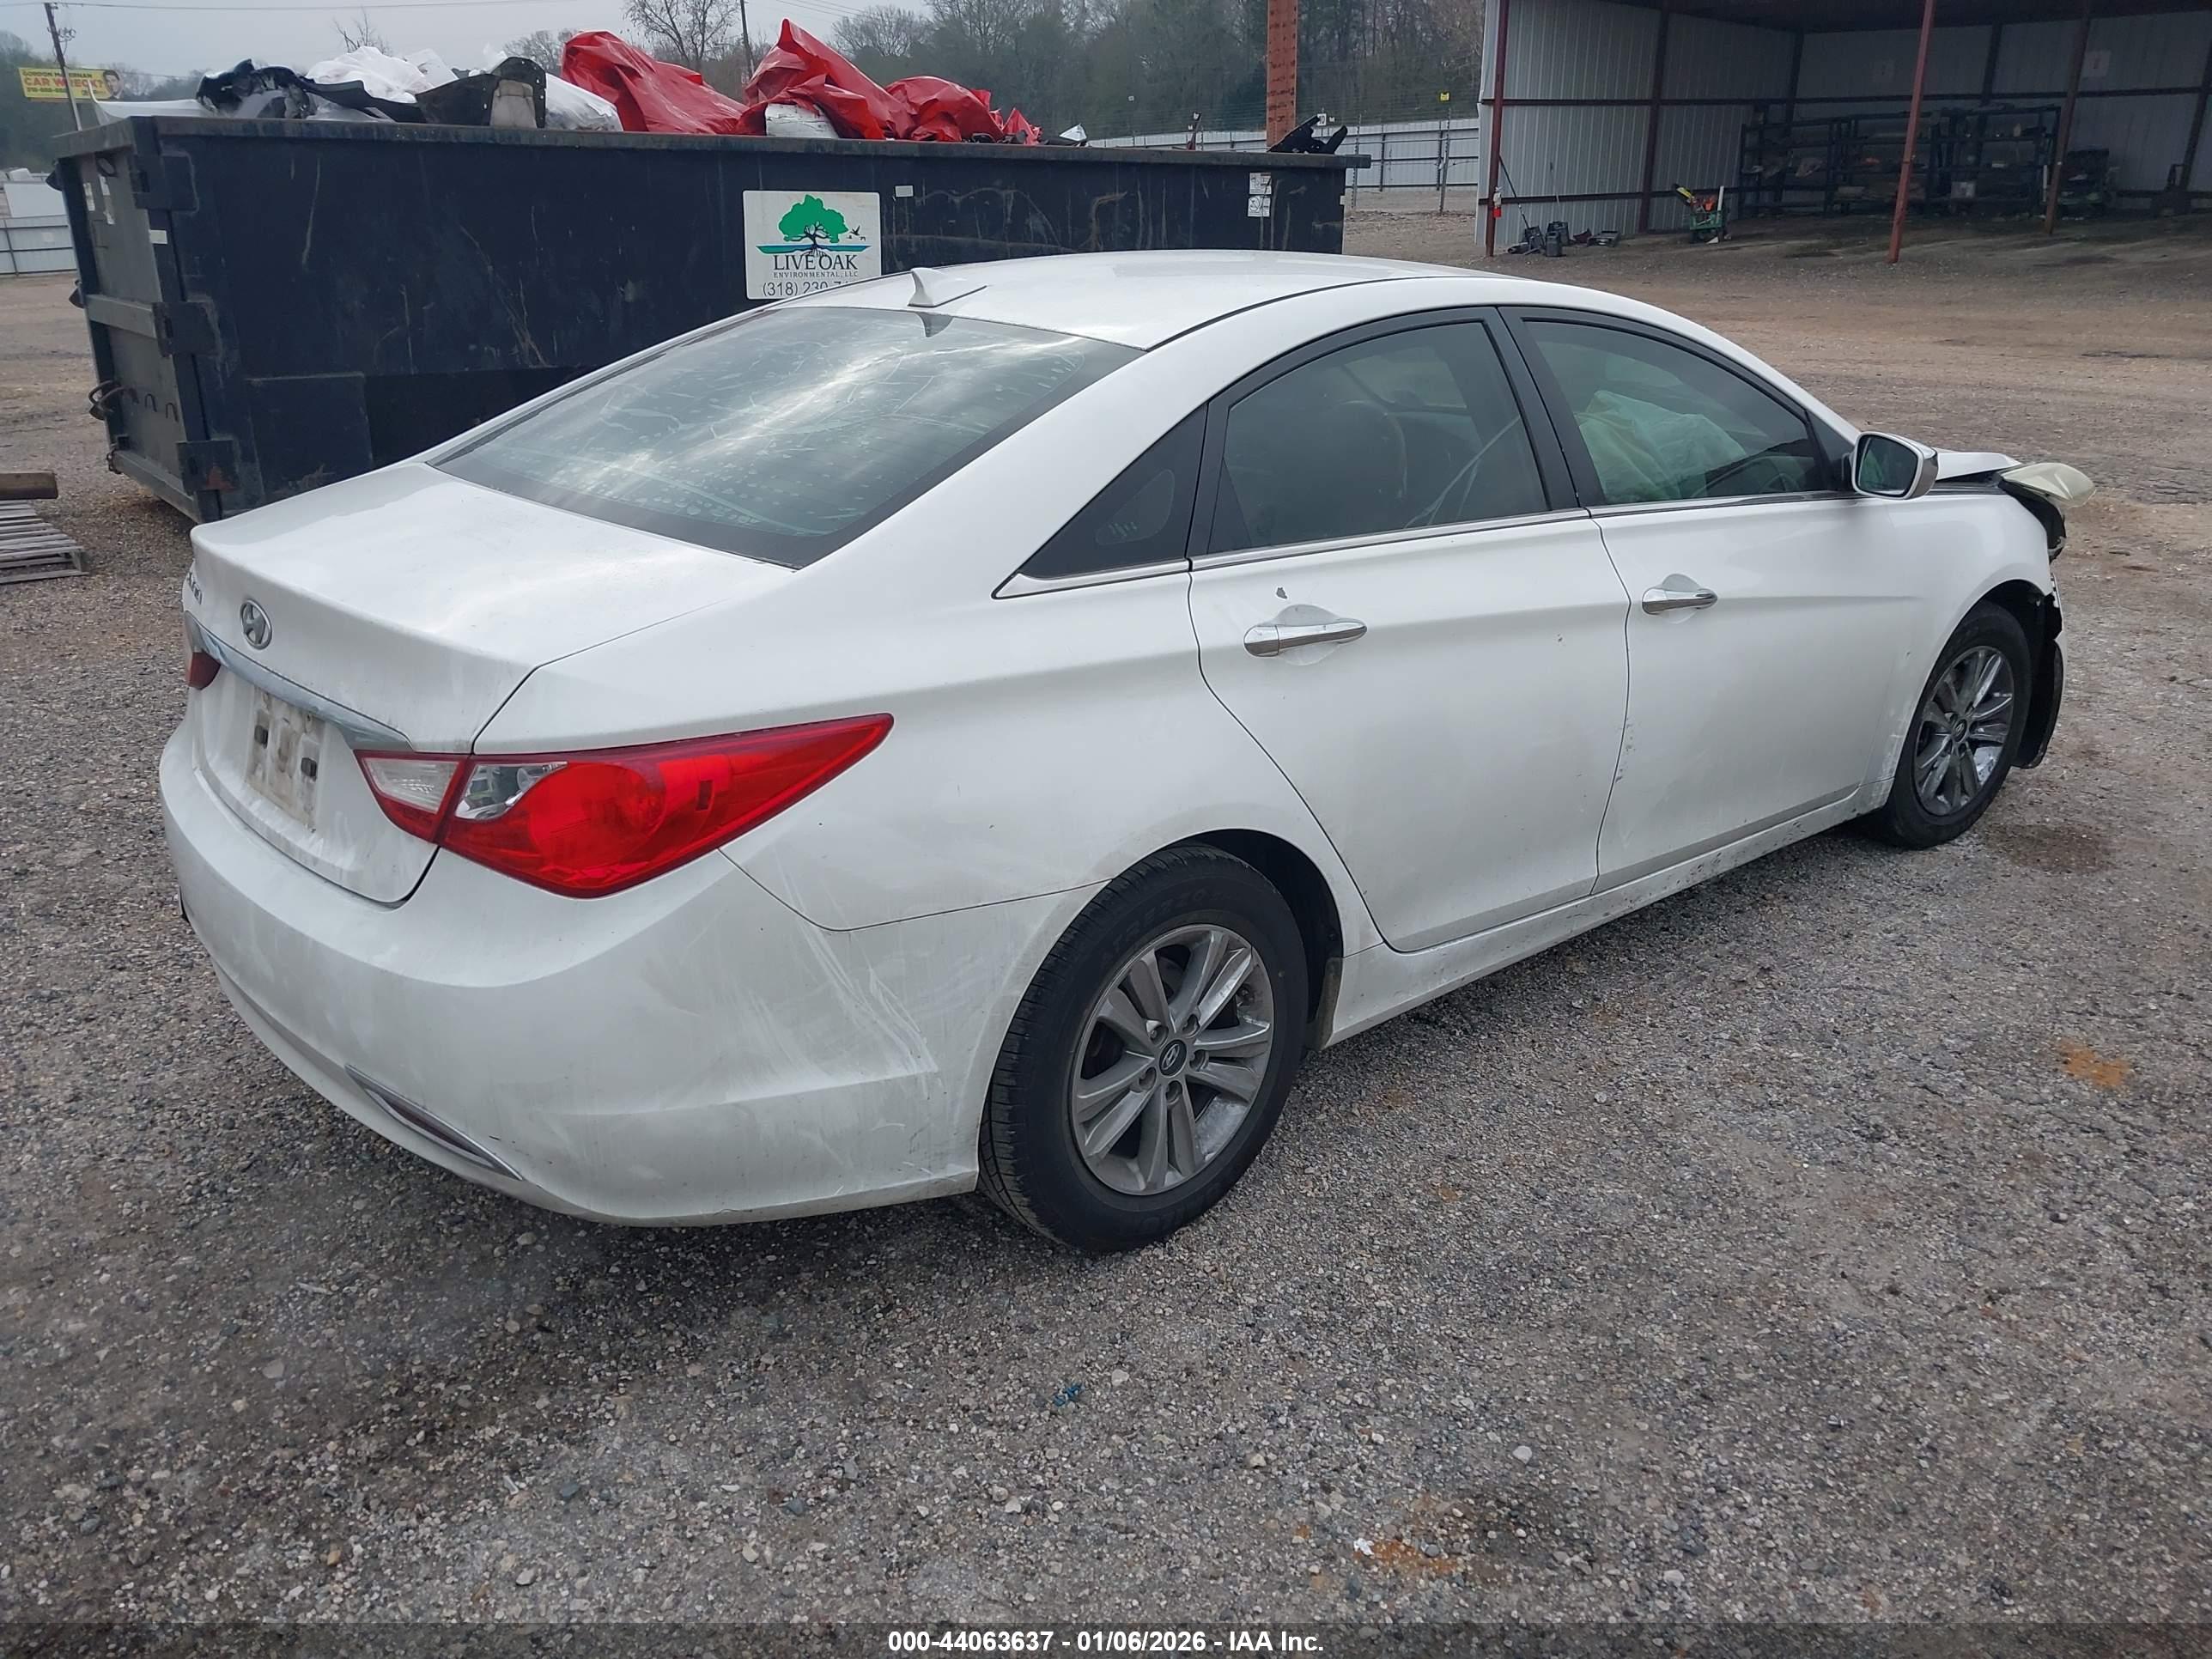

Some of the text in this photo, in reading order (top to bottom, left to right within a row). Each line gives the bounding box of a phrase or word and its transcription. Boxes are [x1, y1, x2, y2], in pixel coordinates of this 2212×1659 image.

[24, 77, 50, 86] CAR
[774, 254, 858, 270] LIVE OAK
[763, 282, 799, 297] (318)
